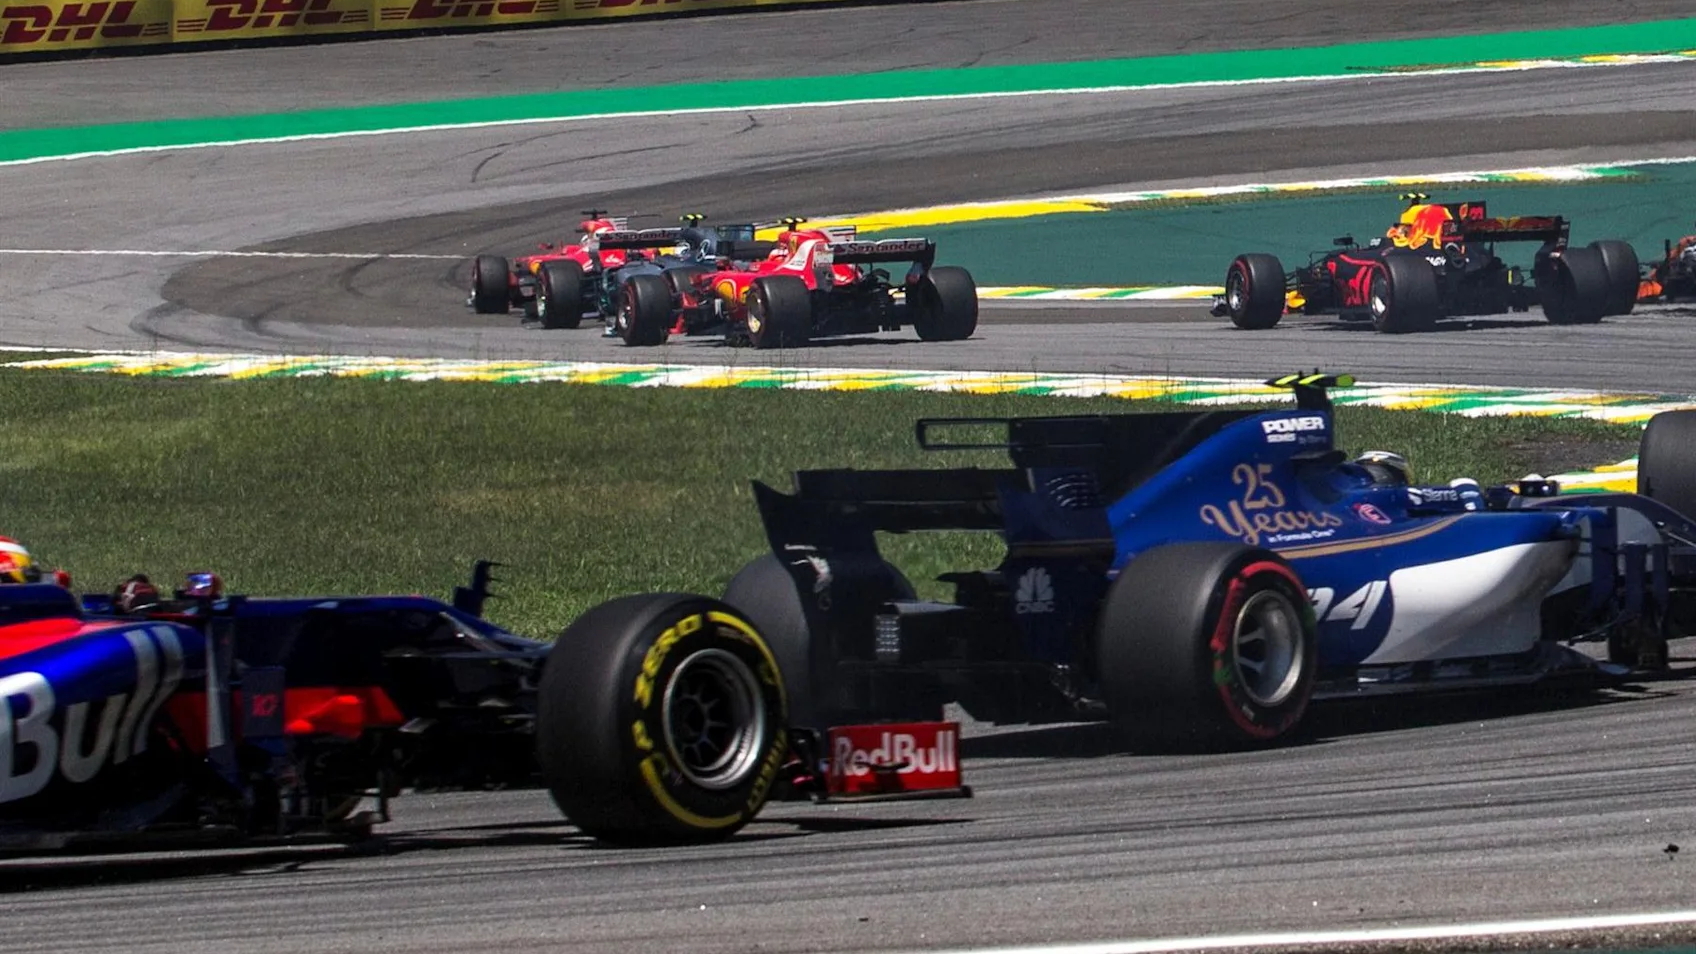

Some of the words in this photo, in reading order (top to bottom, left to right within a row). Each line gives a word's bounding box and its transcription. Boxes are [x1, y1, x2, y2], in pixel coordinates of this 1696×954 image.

[2, 0, 143, 44] DHL
[848, 240, 924, 254] Santander
[1261, 416, 1325, 434] POWER
[1231, 462, 1286, 511] 25
[1199, 499, 1344, 546] Years
[1276, 532, 1312, 543] Formula
[0, 624, 184, 806] Bull
